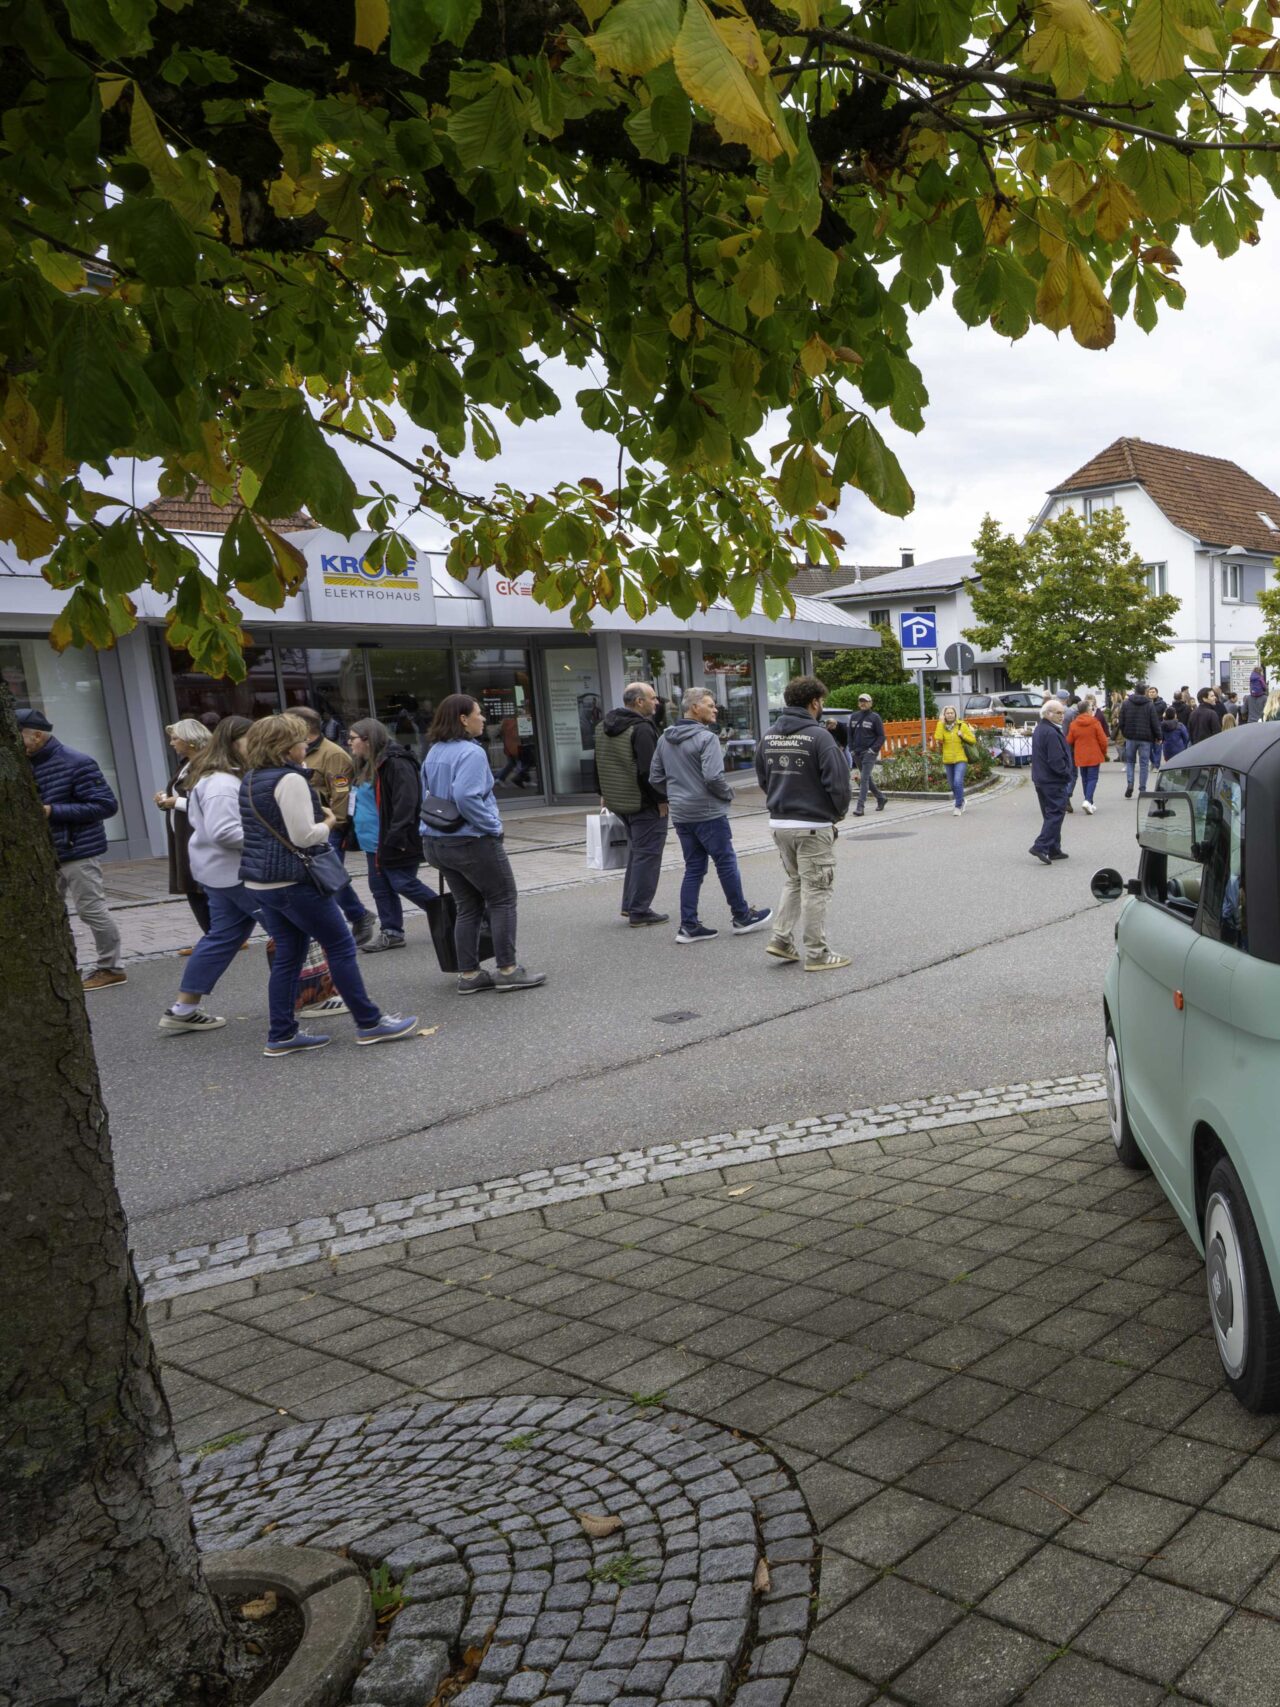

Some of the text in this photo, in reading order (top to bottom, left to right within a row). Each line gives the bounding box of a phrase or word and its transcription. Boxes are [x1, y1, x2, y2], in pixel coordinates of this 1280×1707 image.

[321, 554, 417, 579] KROF
[325, 588, 421, 601] ELEKTROHAUS
[912, 624, 928, 646] P
